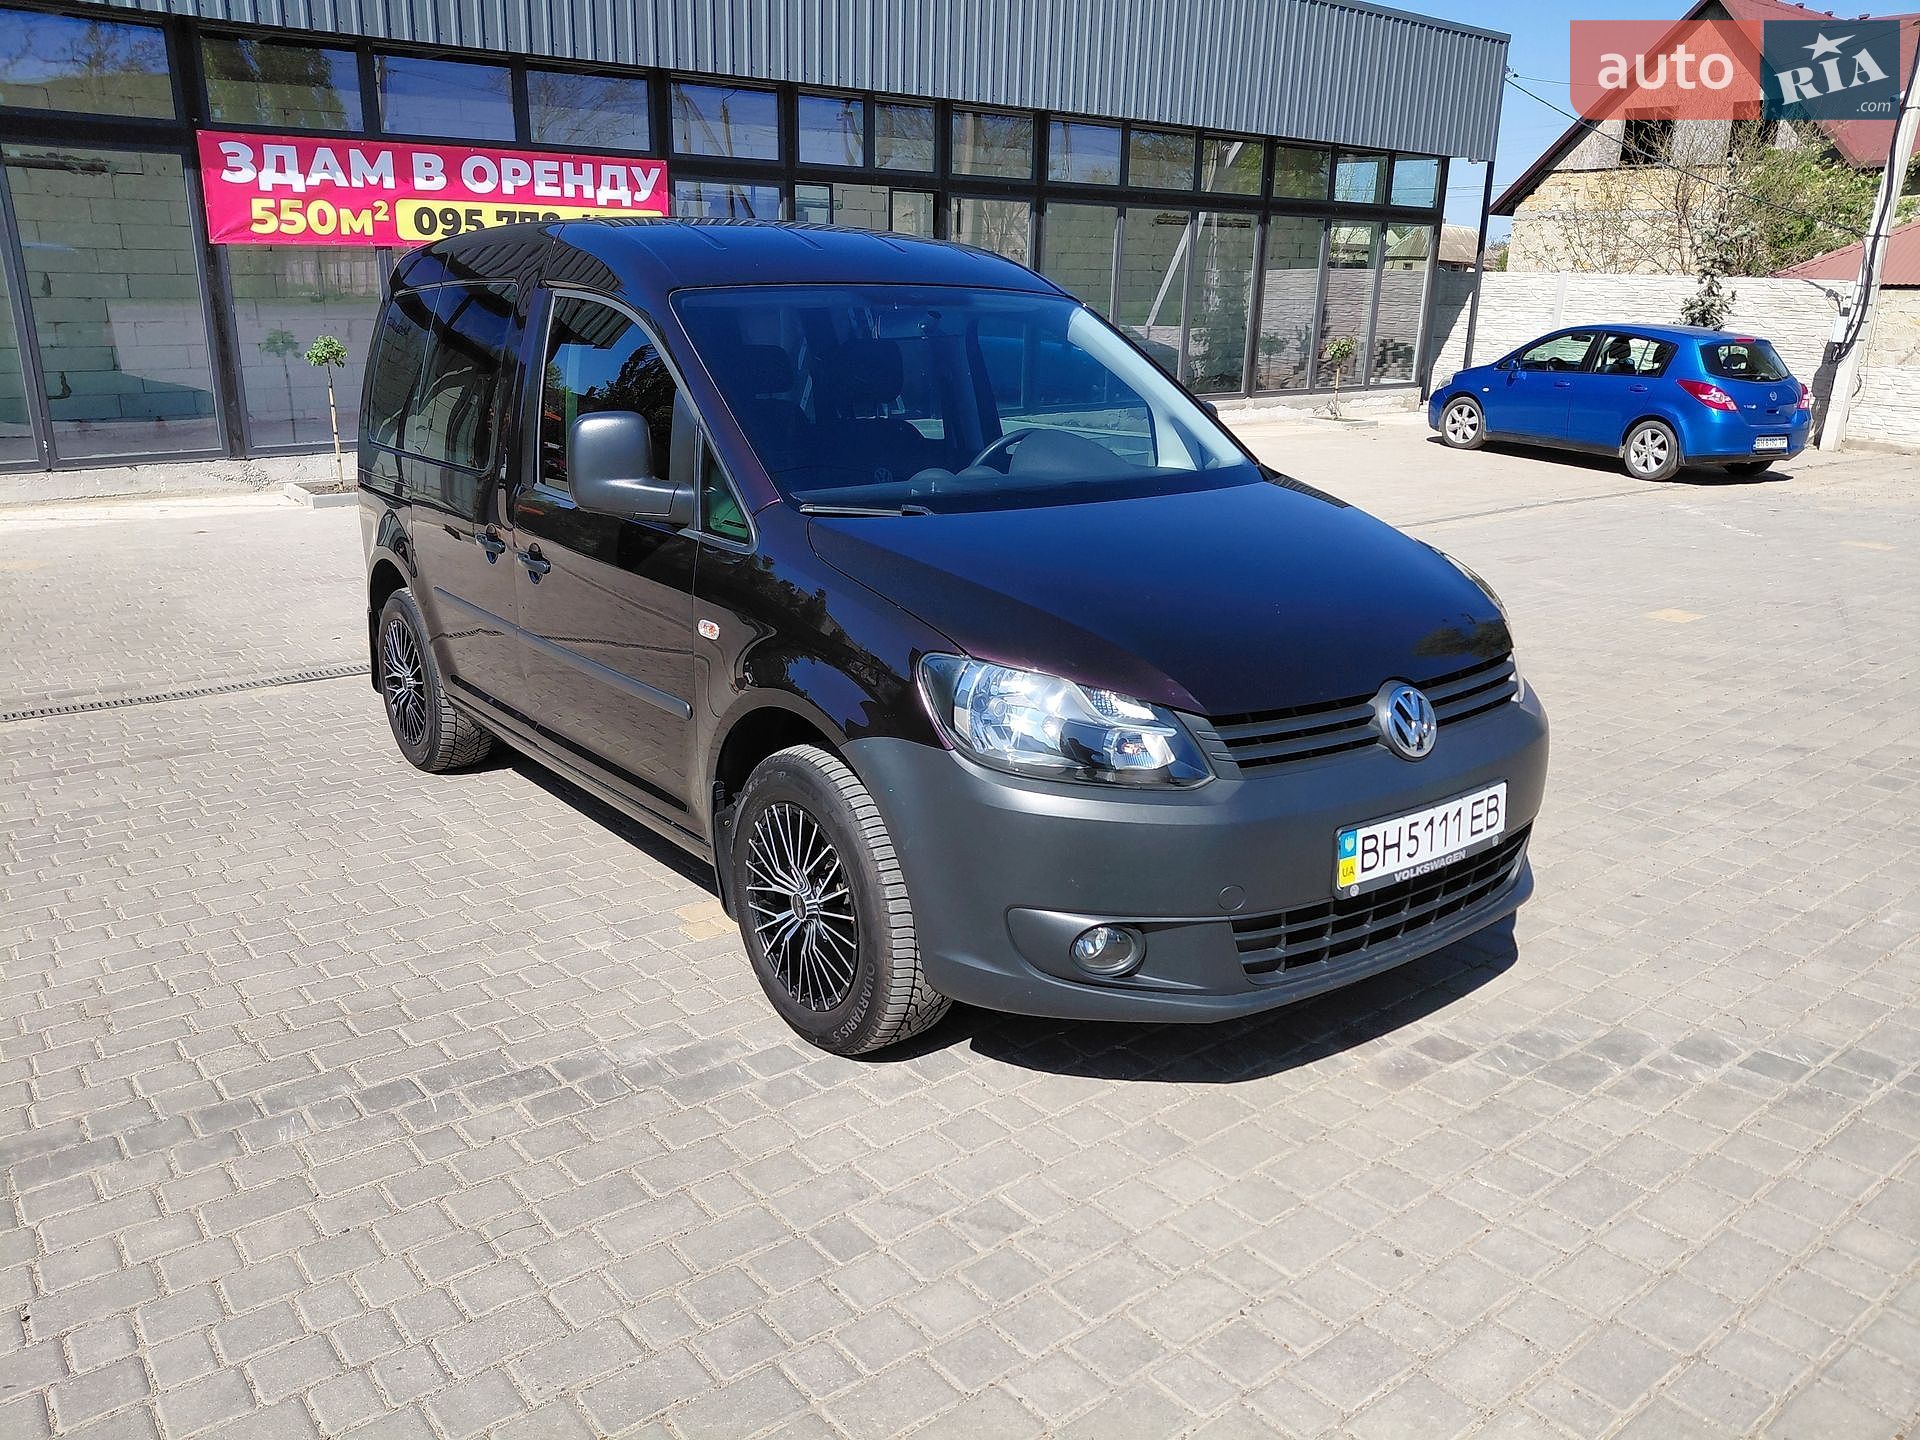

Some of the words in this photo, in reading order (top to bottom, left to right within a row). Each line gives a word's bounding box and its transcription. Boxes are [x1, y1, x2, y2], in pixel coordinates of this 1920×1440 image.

[219, 141, 396, 193] ЗДАМ
[412, 152, 447, 192] В
[460, 155, 661, 207] ОРЕНДУ
[413, 206, 485, 236] 095
[1342, 864, 1355, 878] UA
[1393, 849, 1468, 882] VOLKSWAGEN
